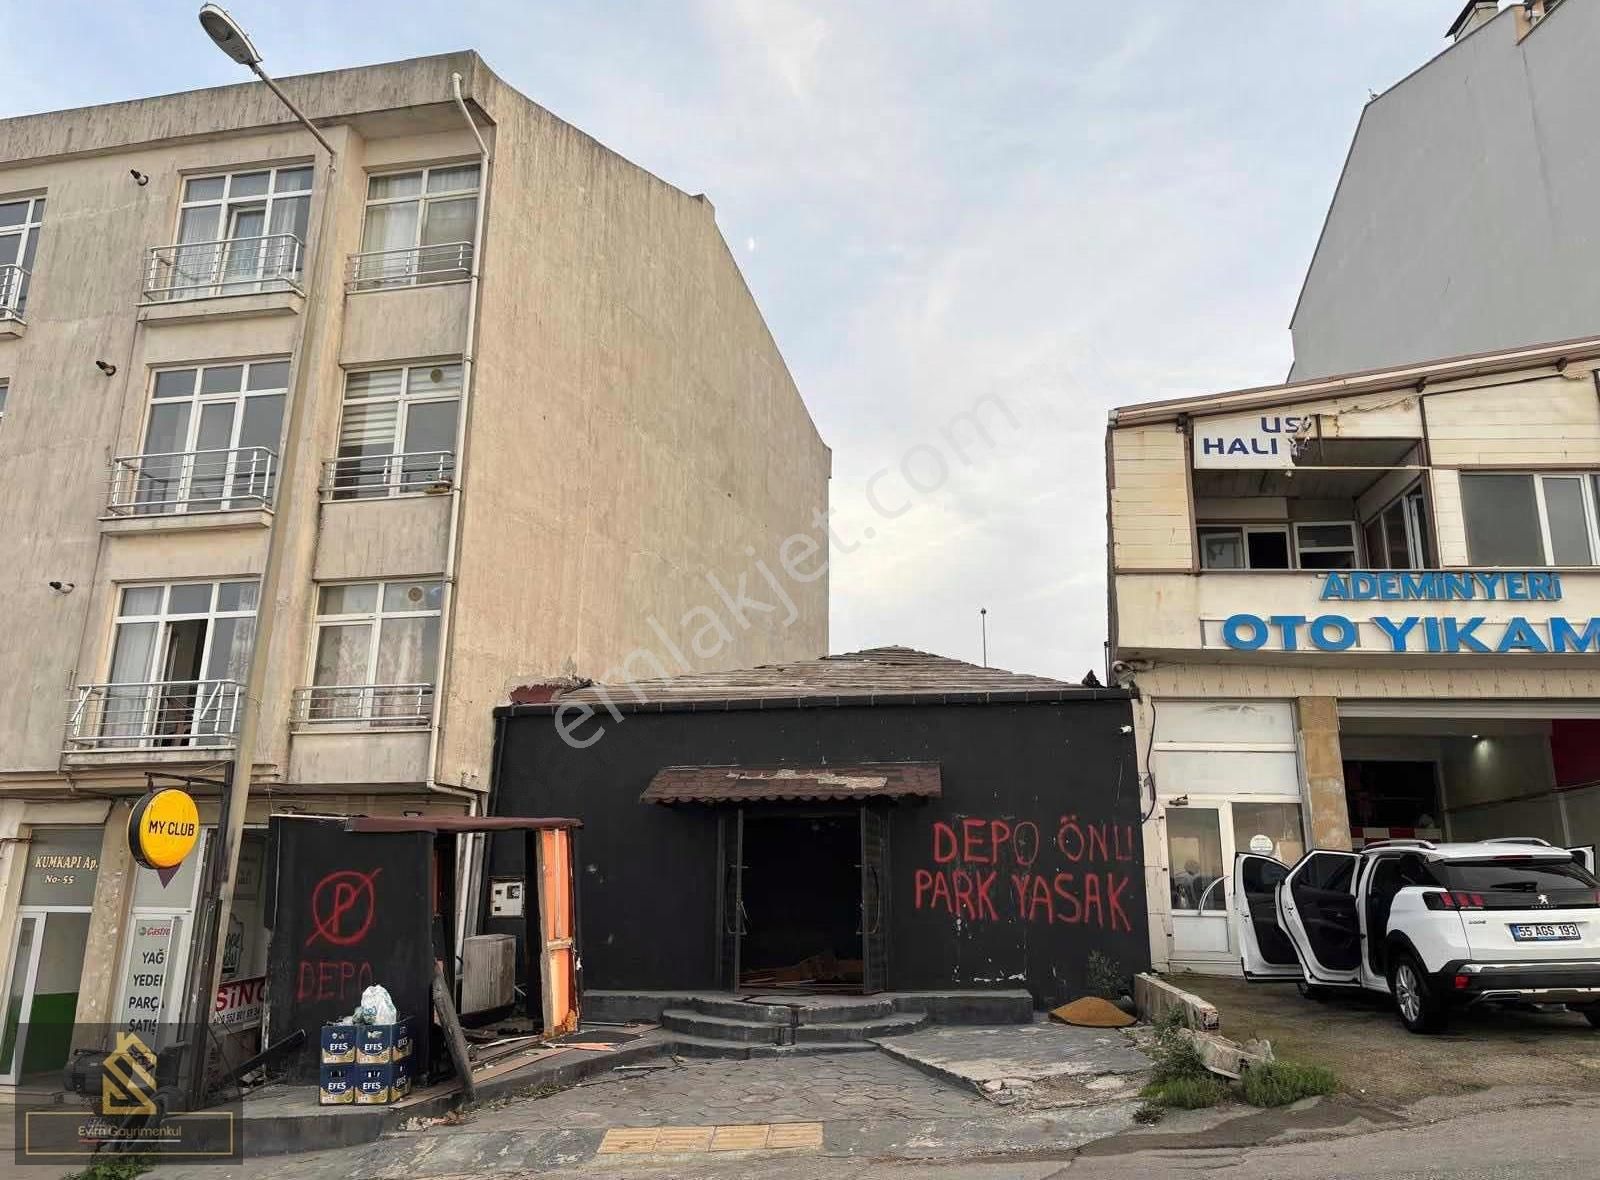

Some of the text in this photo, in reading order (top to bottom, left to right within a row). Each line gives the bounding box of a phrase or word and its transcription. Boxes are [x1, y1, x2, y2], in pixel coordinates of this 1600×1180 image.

[1203, 438, 1278, 455] HALI
[1223, 613, 1357, 651] OTO
[148, 821, 195, 837] MY CLUB
[932, 818, 1040, 866] DEPO
[35, 856, 99, 871] KUMKAPI Ap.
[914, 868, 1132, 932] PARK YASAK
[1518, 924, 1577, 938] 55 AGS 193
[142, 948, 165, 965] YAĞ
[329, 1042, 348, 1051] EFES
[364, 1042, 383, 1051] EFES
[328, 1082, 347, 1090] EFES
[362, 1082, 381, 1090] EFES
